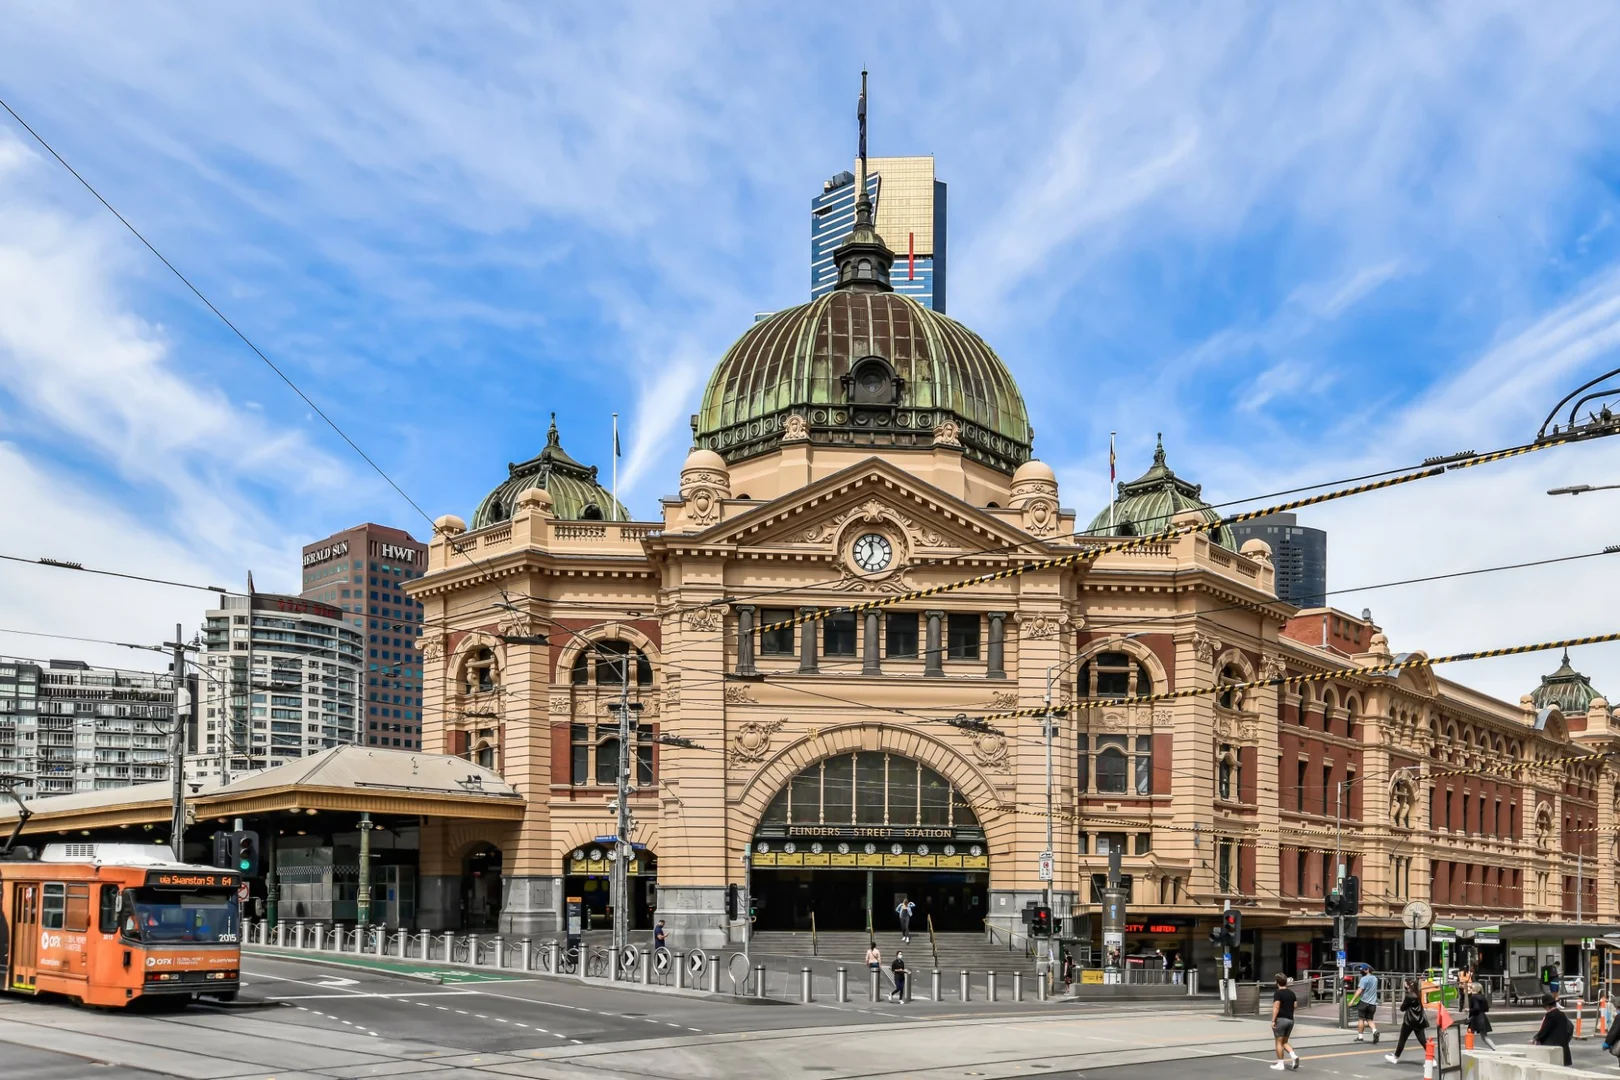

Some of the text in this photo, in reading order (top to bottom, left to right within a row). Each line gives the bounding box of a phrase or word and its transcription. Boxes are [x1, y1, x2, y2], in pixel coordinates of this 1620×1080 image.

[301, 541, 348, 566] HERALD SUN
[382, 543, 415, 562] HWT
[789, 826, 952, 838] FLINDERS STREET STATION
[160, 875, 215, 886] via Swanston St
[221, 877, 232, 887] 64
[219, 933, 237, 942] 2015
